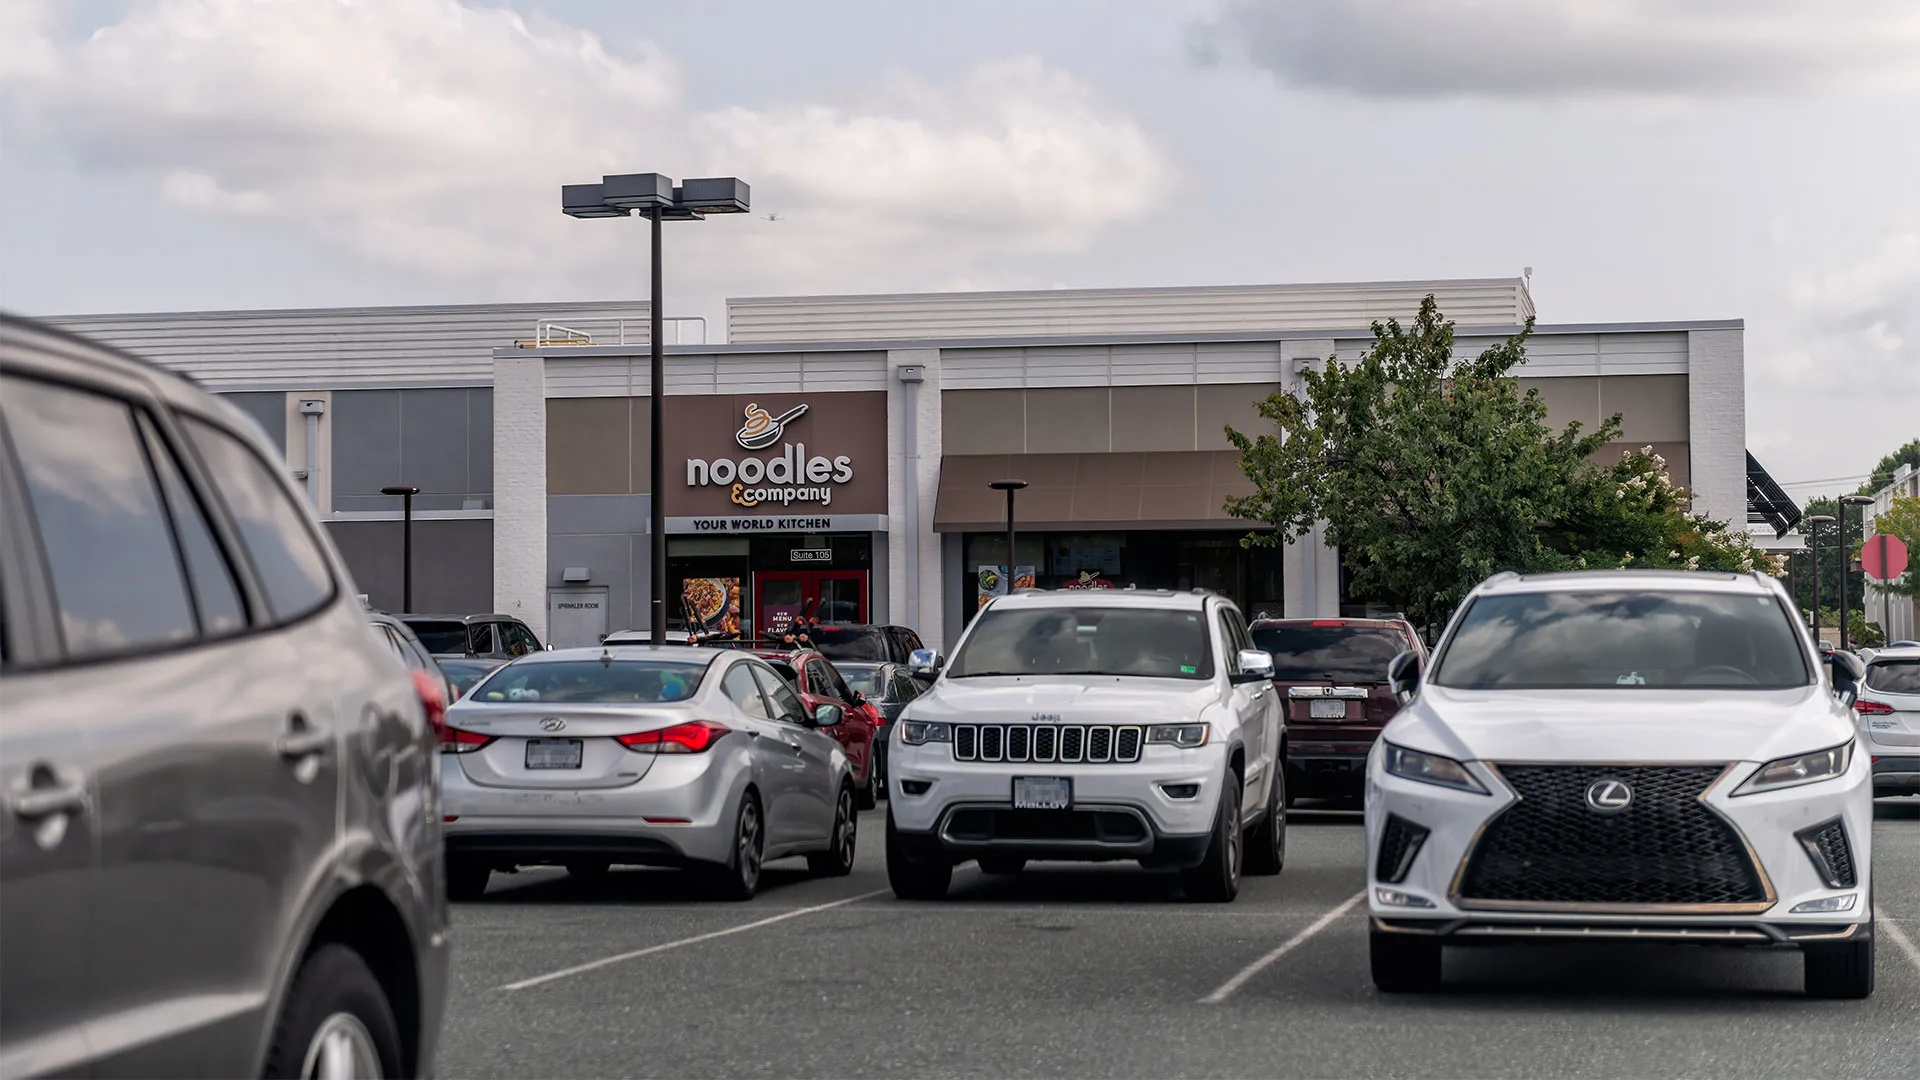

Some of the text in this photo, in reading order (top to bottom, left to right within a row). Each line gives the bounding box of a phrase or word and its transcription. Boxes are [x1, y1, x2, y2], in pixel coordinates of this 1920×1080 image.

[687, 443, 853, 485] noodles
[693, 518, 831, 531] YOUR WORLD KITCHEN
[792, 551, 830, 560] Suite 105
